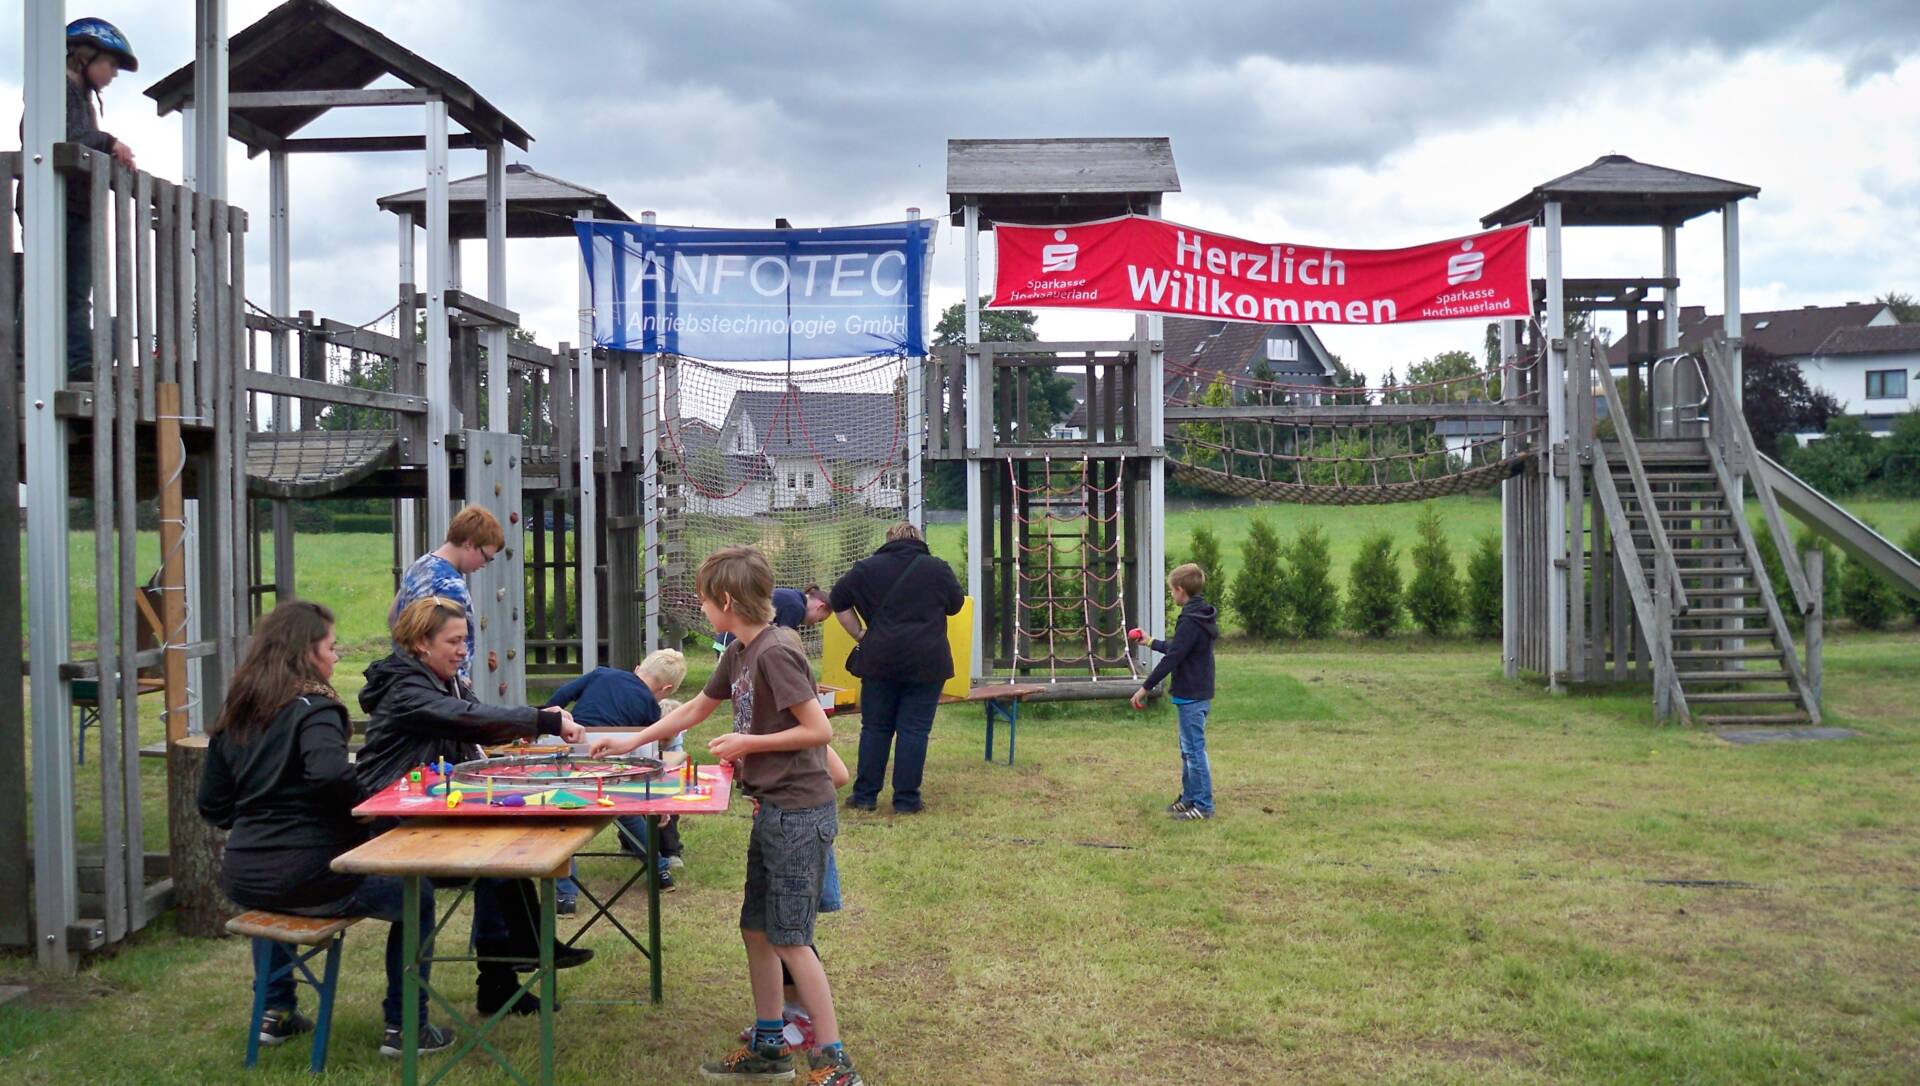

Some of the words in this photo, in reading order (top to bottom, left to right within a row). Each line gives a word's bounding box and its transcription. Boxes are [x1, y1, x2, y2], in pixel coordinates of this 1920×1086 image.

[1176, 230, 1346, 286] Herzlich
[631, 249, 906, 297] ANFOTEC
[1027, 278, 1086, 291] Sparkasse
[1127, 264, 1397, 324] Willkommen
[1422, 298, 1511, 317] Hochsauerland
[1435, 288, 1495, 304] Sparkasse
[626, 311, 836, 338] Antriebstechnologie
[845, 315, 906, 335] GmbH
